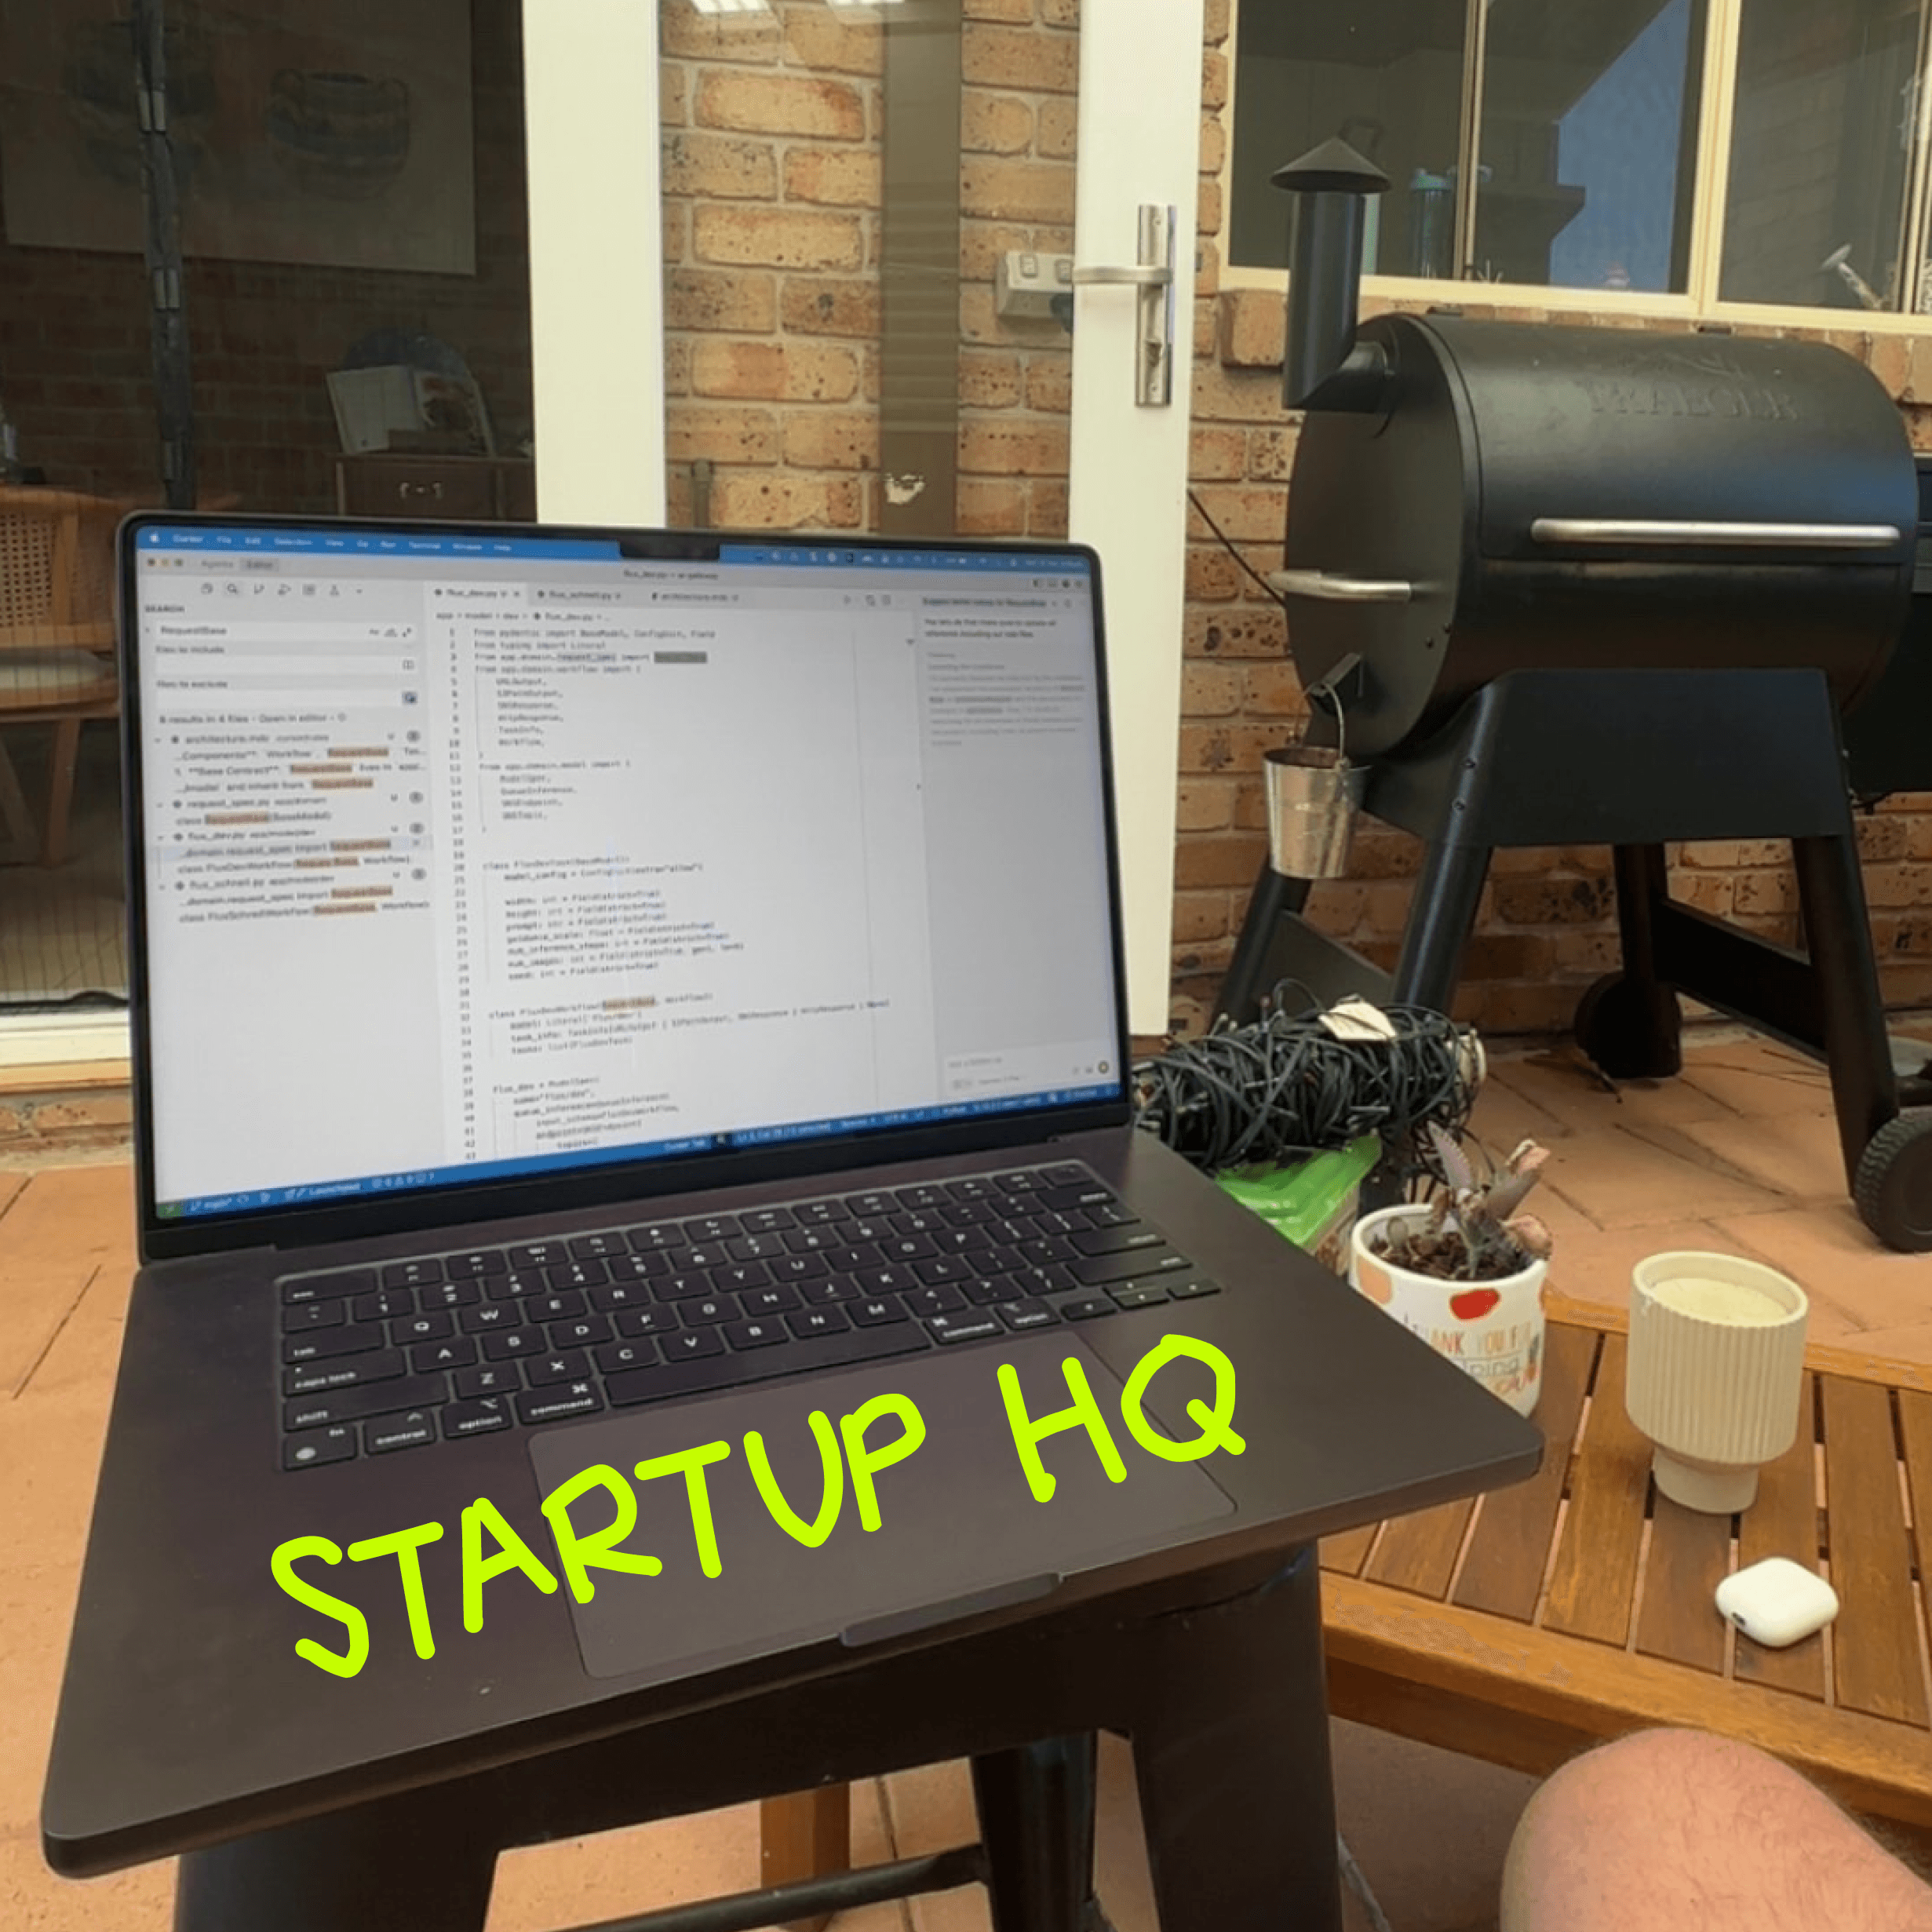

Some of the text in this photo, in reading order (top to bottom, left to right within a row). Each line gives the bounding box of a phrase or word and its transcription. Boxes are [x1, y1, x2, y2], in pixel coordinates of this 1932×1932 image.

[790, 1258, 805, 1271] U
[762, 1292, 779, 1304] H
[479, 1308, 499, 1321] W
[868, 1303, 886, 1317] M
[413, 1320, 430, 1333] Q
[810, 1314, 826, 1326] N
[574, 1324, 590, 1336] D
[683, 1336, 698, 1348] V
[437, 1347, 453, 1359] A
[618, 1347, 634, 1361] C
[549, 1358, 565, 1372] X
[294, 1370, 357, 1389] caps lock
[480, 1371, 495, 1386] Z
[530, 1396, 594, 1416] command
[296, 1409, 329, 1423] shift
[458, 1415, 502, 1431] option
[376, 1427, 427, 1445] control
